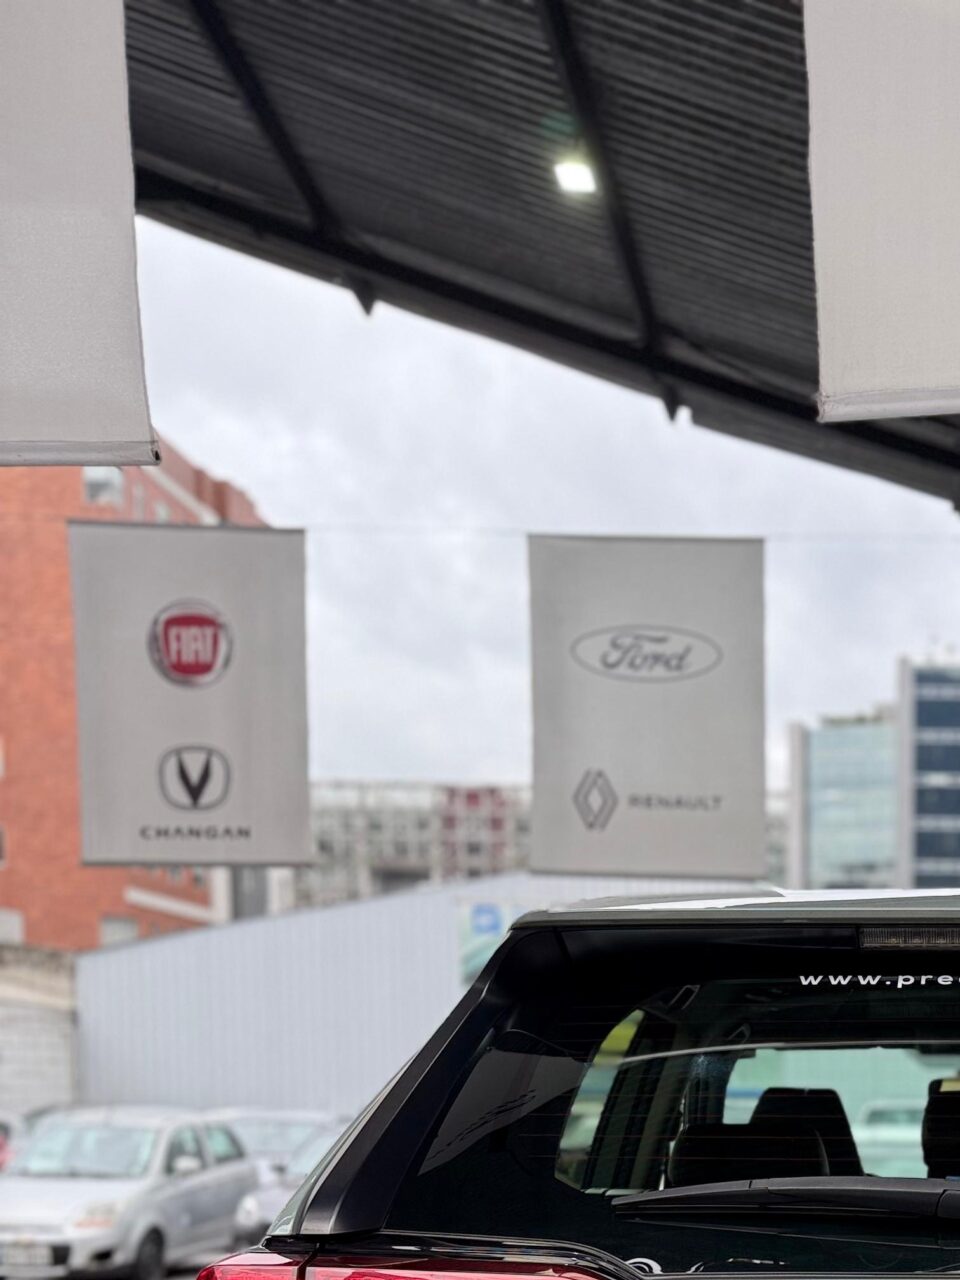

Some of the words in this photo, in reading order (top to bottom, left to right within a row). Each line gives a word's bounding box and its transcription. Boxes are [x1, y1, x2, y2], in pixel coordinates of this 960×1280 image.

[168, 625, 217, 664] FIAT
[601, 633, 694, 672] Ford
[139, 824, 252, 841] CHANGAN
